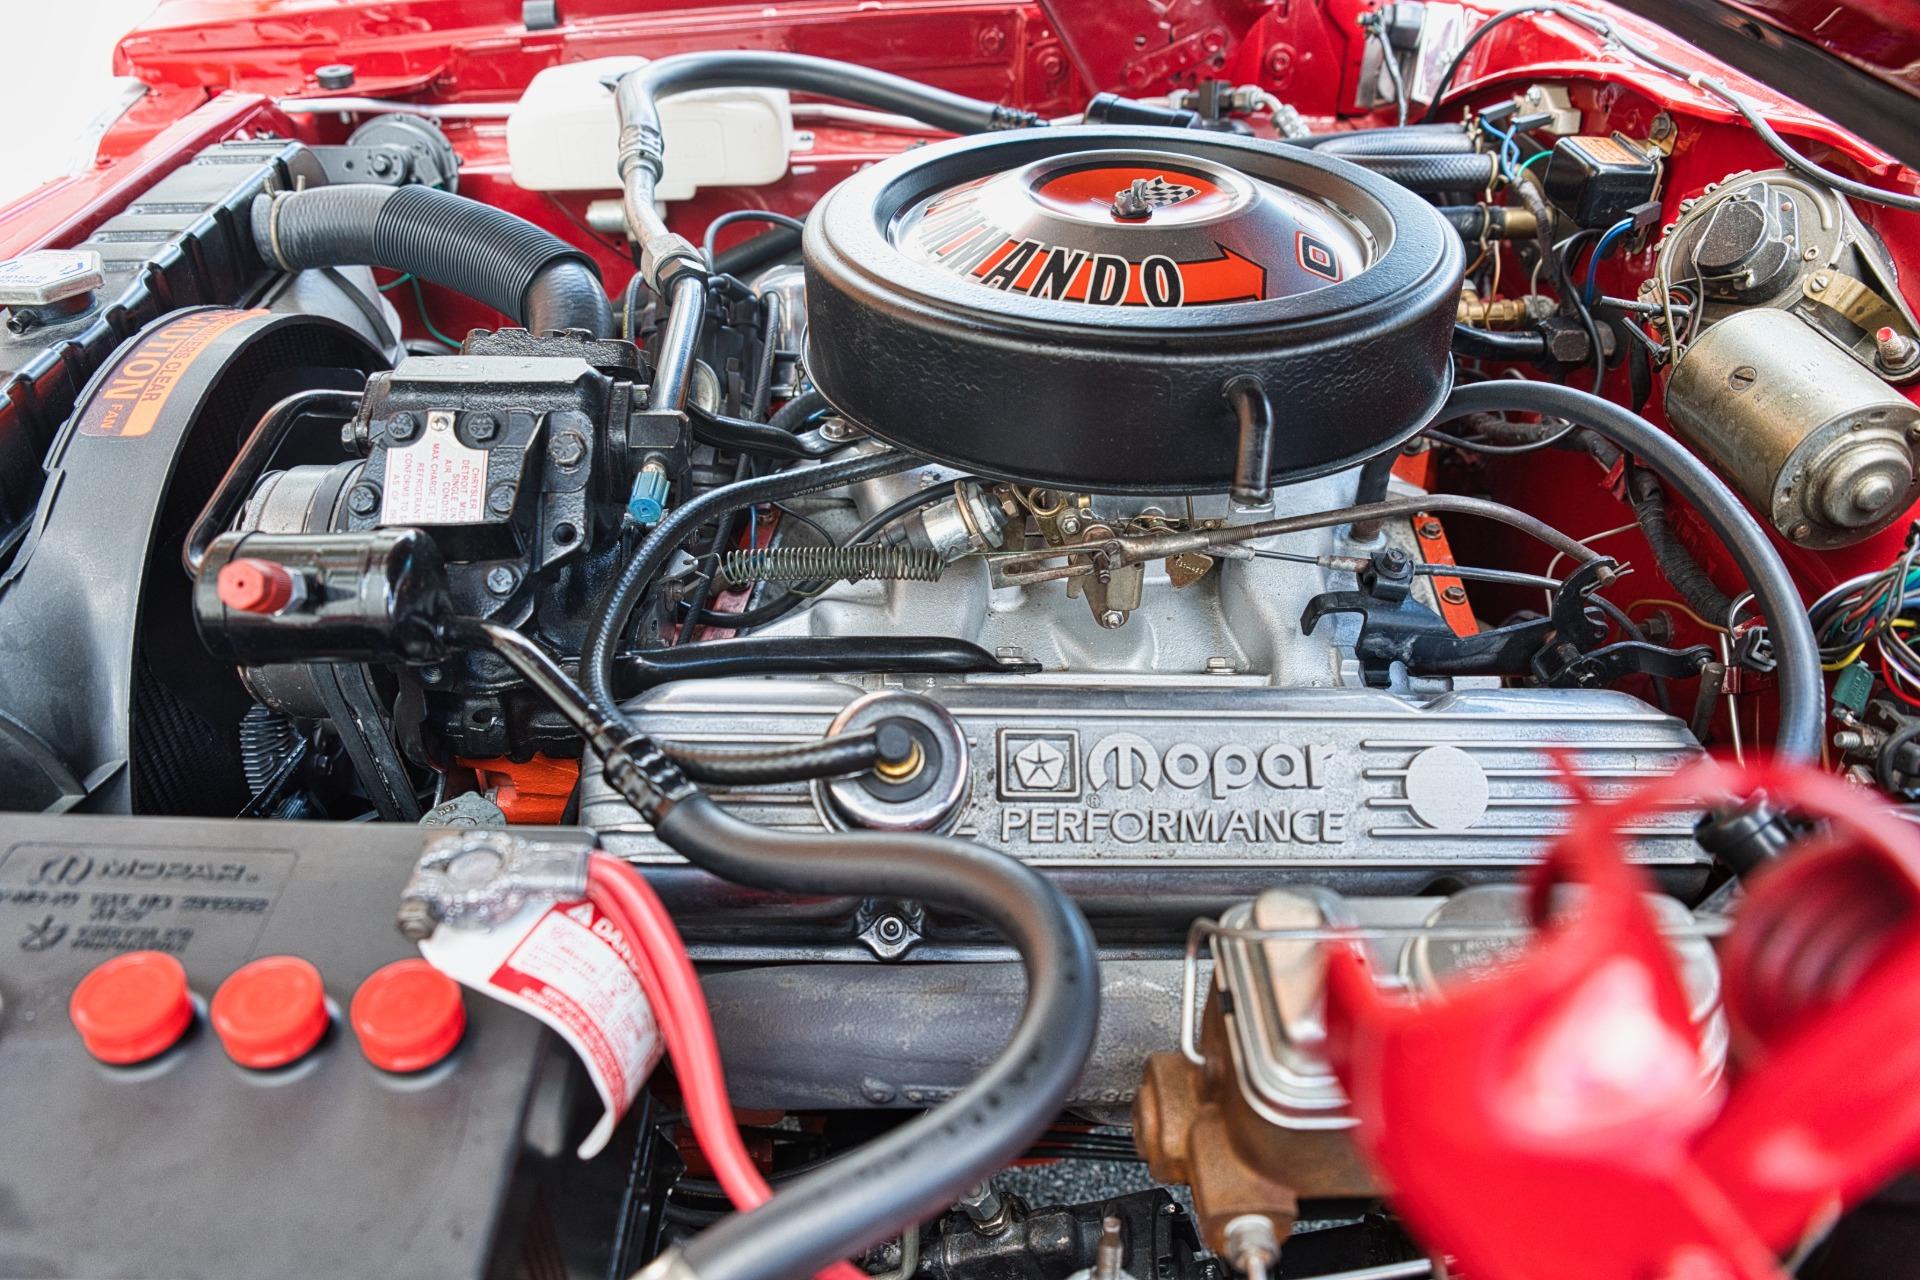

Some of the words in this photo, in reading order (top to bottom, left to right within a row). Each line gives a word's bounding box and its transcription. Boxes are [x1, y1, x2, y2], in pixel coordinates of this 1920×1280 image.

[142, 361, 182, 401] CLEAR
[100, 403, 124, 430] FAN
[402, 453, 413, 497] CONFORMS
[429, 464, 439, 497] CHARGE
[445, 459, 453, 473] AIR
[461, 460, 470, 494] DETROIT
[414, 463, 424, 519] REFRIGERANT
[451, 474, 460, 502] SINGLE
[470, 468, 480, 509] CHRYSLER
[1000, 807, 1347, 845] PERFORMANCE
